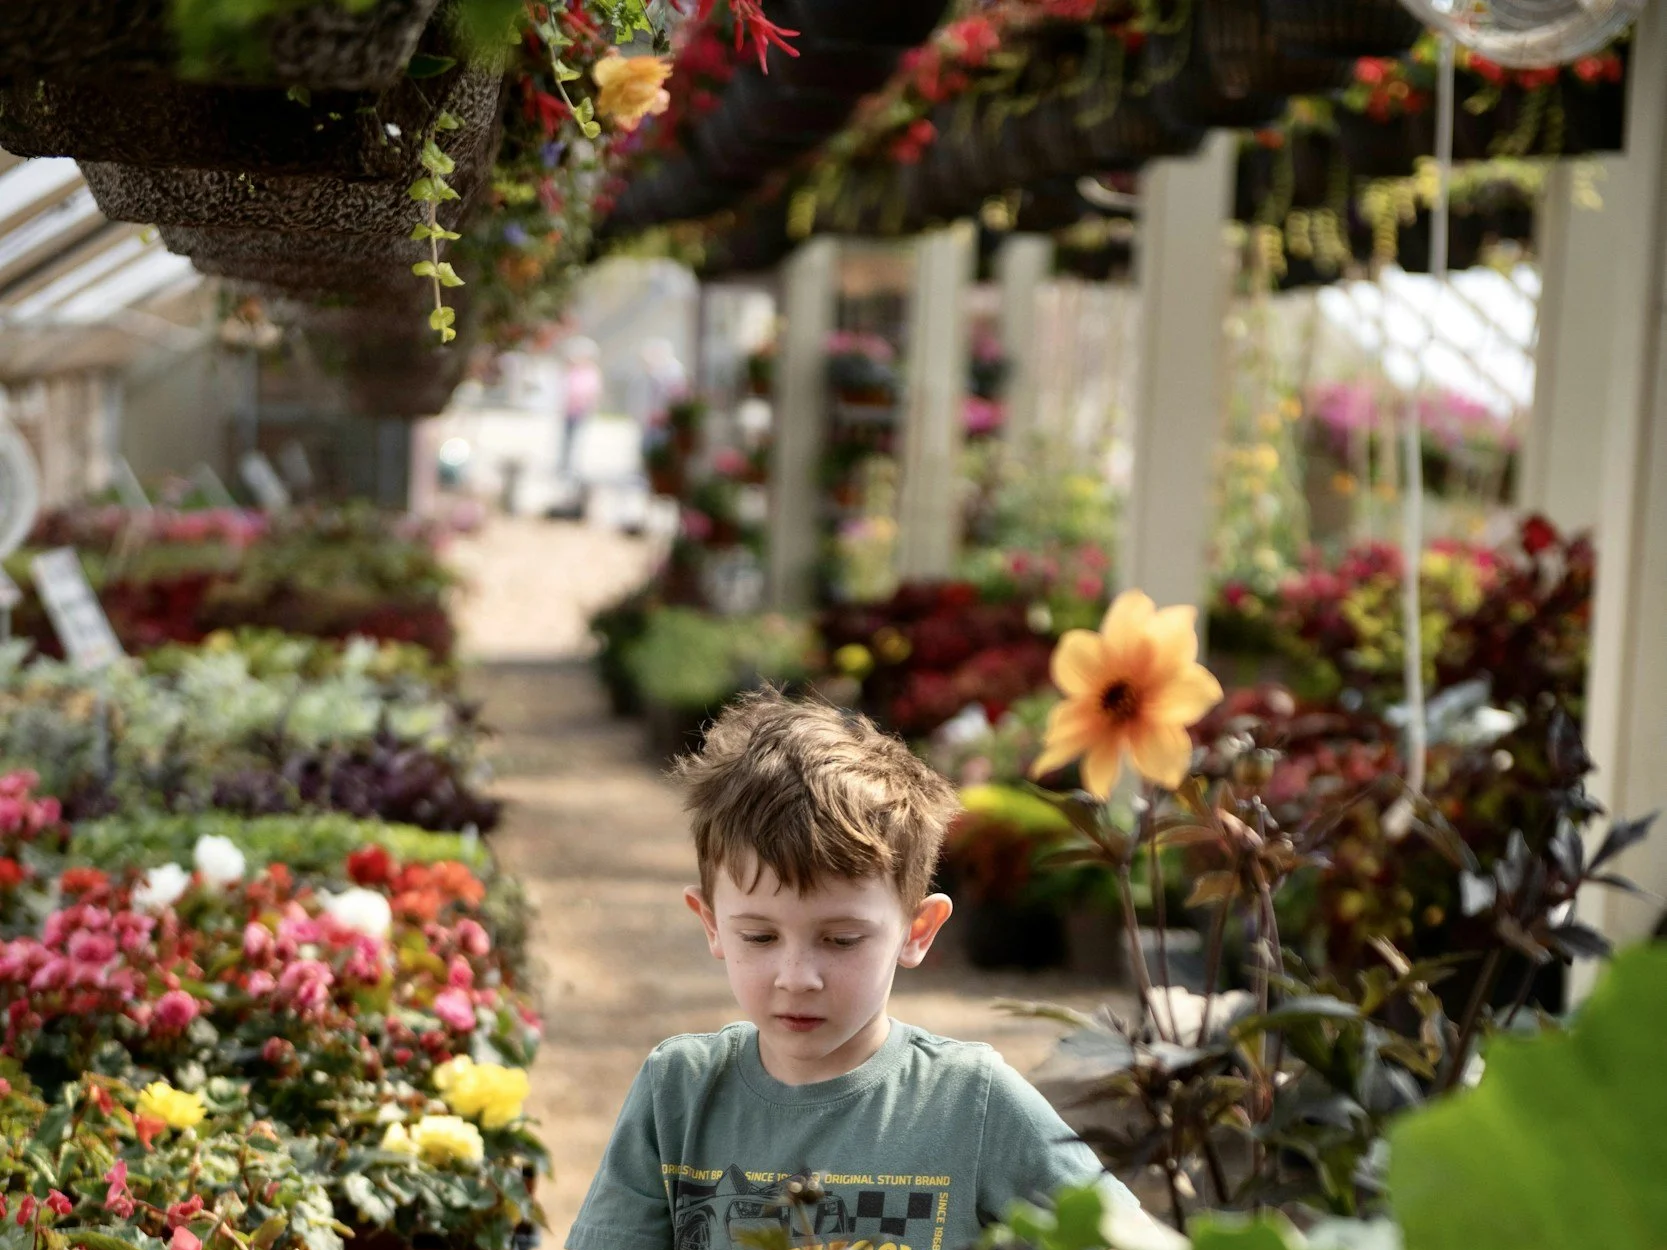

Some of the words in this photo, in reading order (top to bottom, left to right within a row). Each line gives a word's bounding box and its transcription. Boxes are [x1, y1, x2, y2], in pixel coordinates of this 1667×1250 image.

[682, 1165, 710, 1180] STUNT
[744, 1171, 775, 1183] SINCE
[824, 1174, 875, 1185] ORIGINAL
[877, 1175, 913, 1186] STUNT
[915, 1175, 951, 1186] BRAND
[936, 1192, 949, 1224] SINCE
